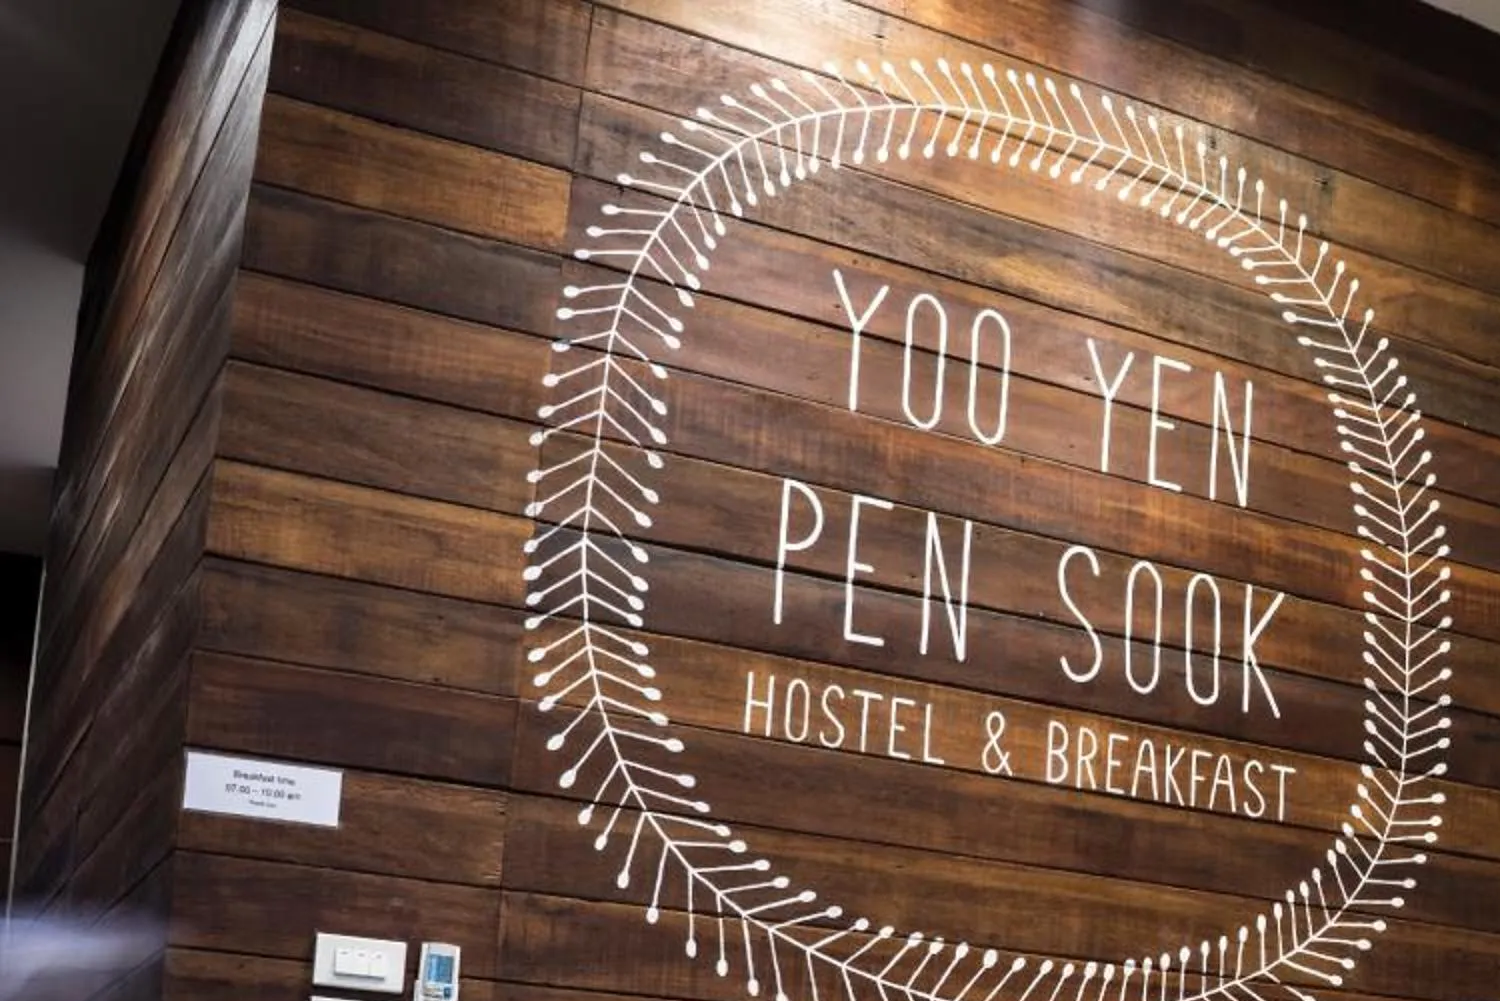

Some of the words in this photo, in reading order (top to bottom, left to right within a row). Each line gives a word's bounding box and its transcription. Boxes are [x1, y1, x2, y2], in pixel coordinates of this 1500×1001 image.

[833, 269, 1011, 445] YOO
[1086, 337, 1253, 508] YEN
[773, 478, 972, 662] PEN
[1058, 545, 1286, 719] SOOK
[742, 671, 945, 766] HOSTEL
[981, 710, 1013, 777] &
[1045, 720, 1296, 822] BREAKFAST
